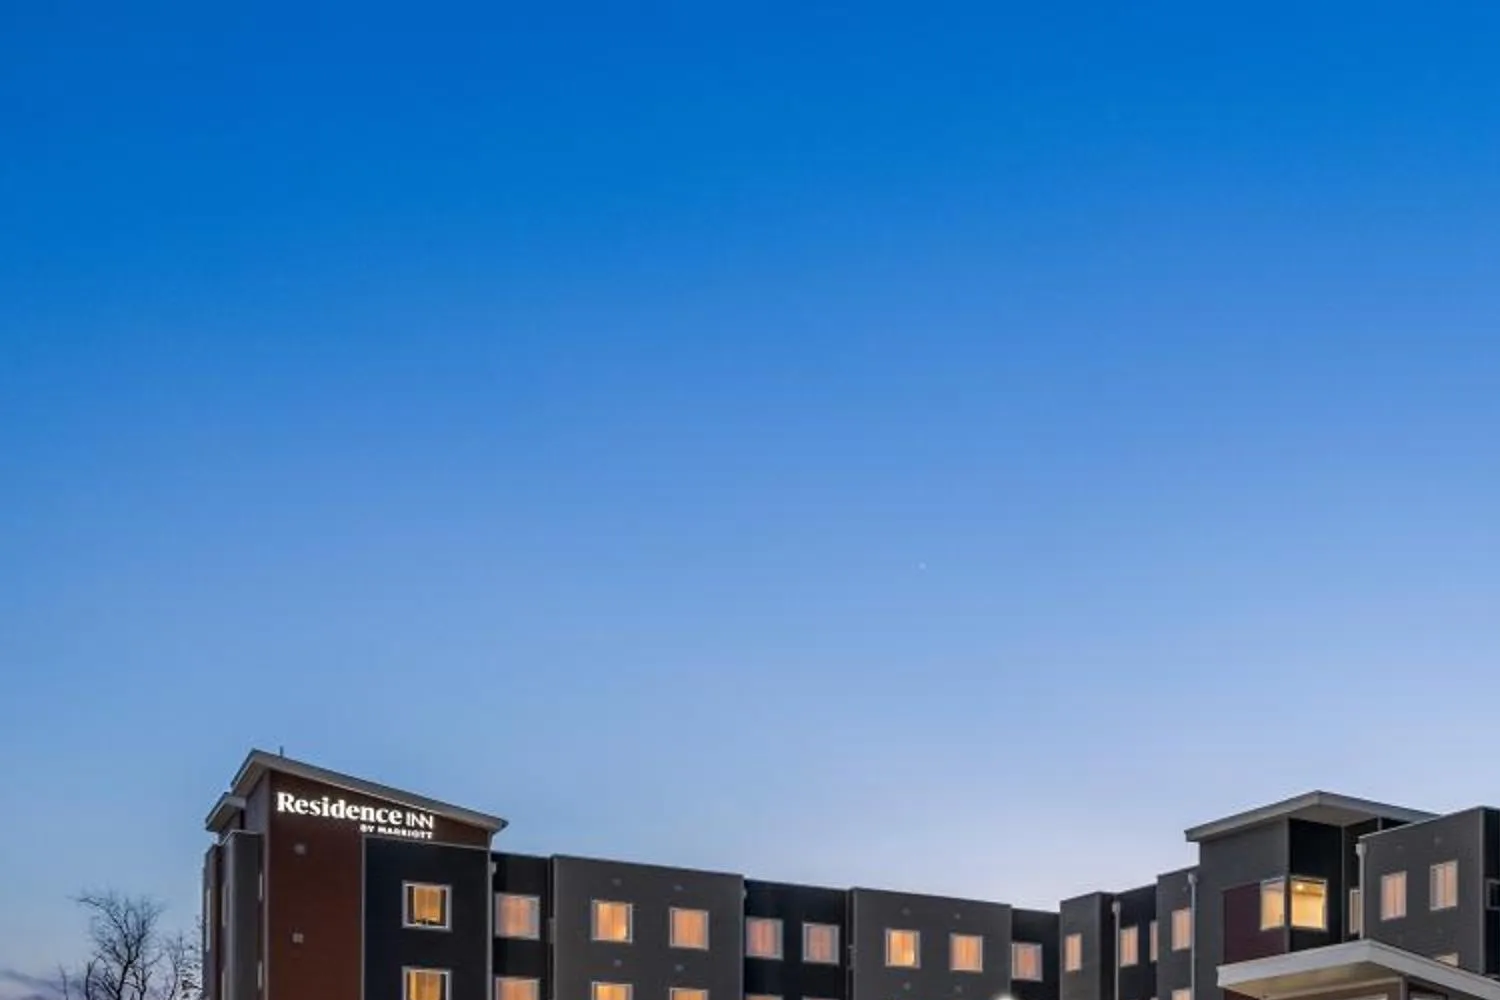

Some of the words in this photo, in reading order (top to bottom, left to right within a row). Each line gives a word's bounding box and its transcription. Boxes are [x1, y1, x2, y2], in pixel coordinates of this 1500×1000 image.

[276, 791, 403, 826] Residence
[405, 811, 434, 830] INN
[359, 823, 374, 834] BY
[377, 823, 434, 840] MARRIOTT
